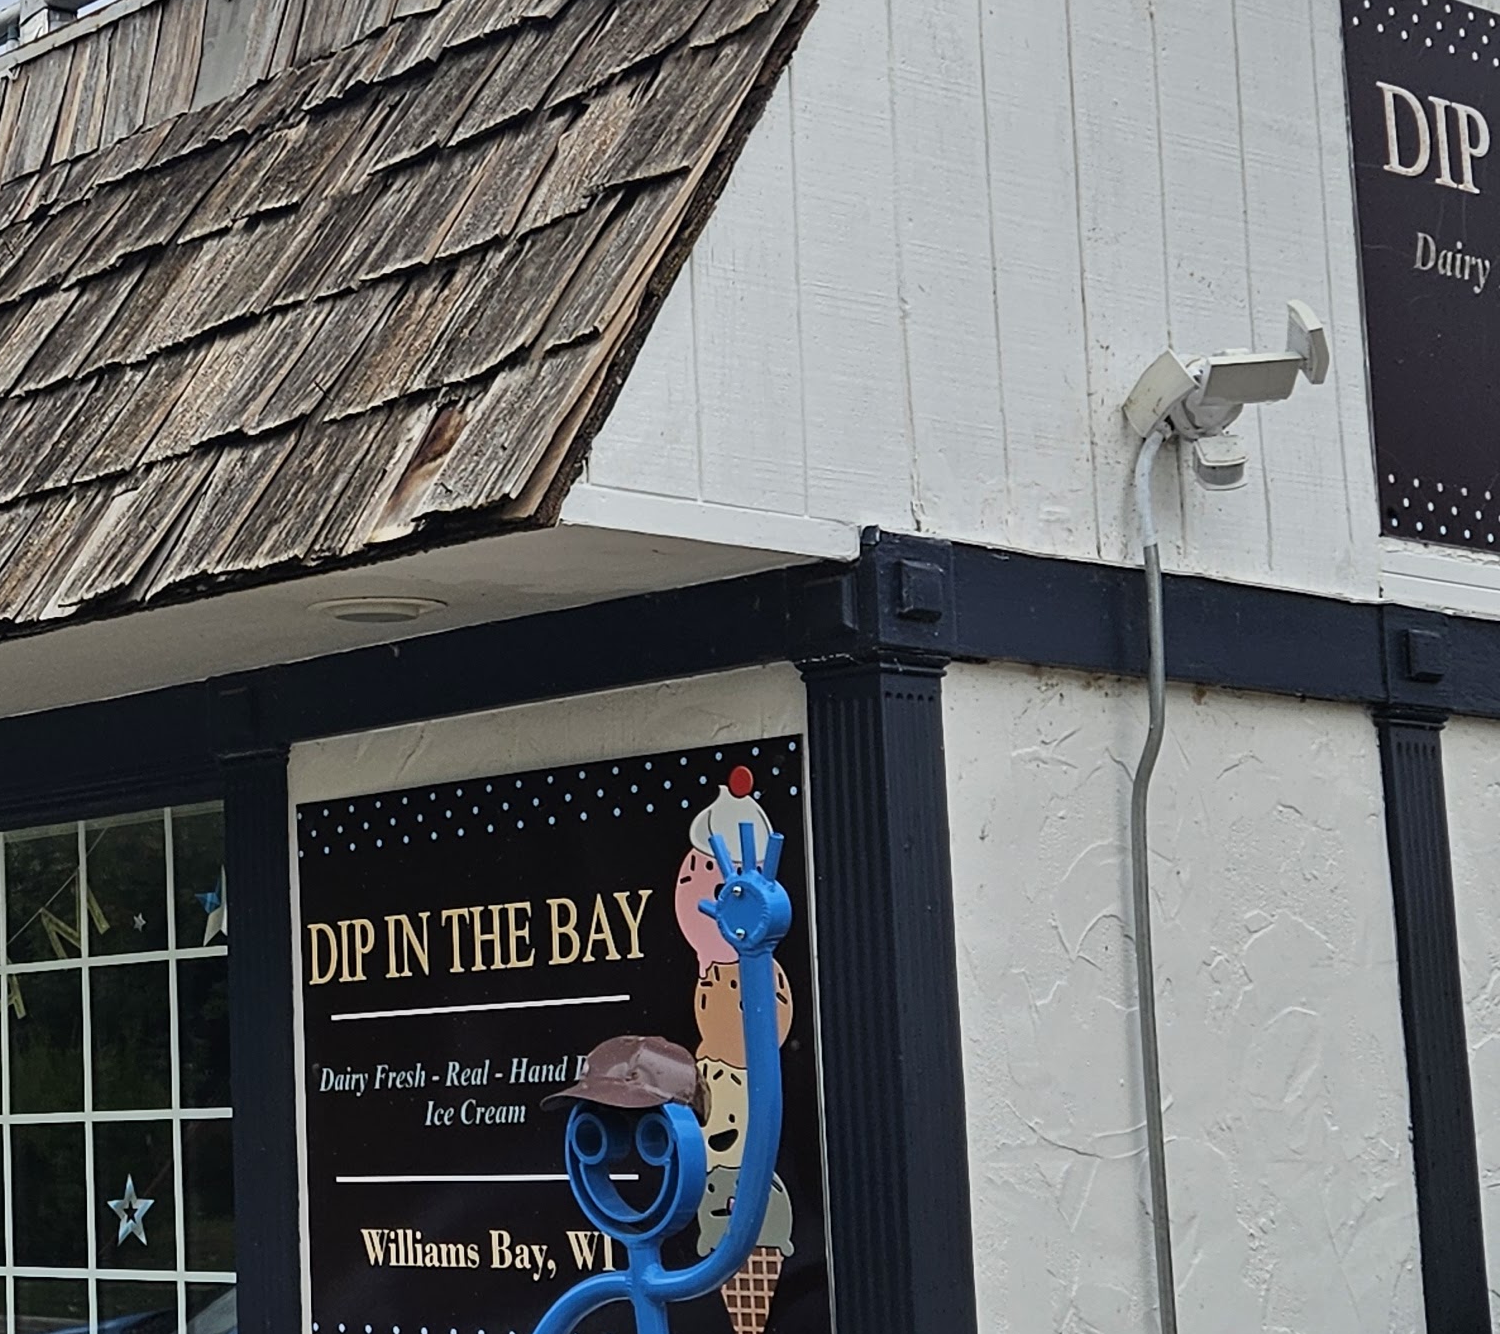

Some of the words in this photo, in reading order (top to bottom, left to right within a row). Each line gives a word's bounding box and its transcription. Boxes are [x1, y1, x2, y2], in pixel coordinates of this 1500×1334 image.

[1375, 80, 1491, 194] DIP
[1414, 231, 1491, 294] Dairy
[307, 918, 375, 985] DIP
[384, 911, 430, 978] IN
[441, 901, 535, 973] THE
[546, 889, 653, 965] BAY
[320, 1067, 368, 1097] Dairy
[374, 1063, 426, 1090] Fresh
[445, 1059, 490, 1087] Real
[509, 1055, 568, 1084] Hand
[425, 1100, 454, 1126] Ice
[460, 1098, 526, 1125] Cream
[361, 1229, 480, 1268] Williams
[489, 1229, 557, 1282] Bay,
[566, 1231, 617, 1272] WI
